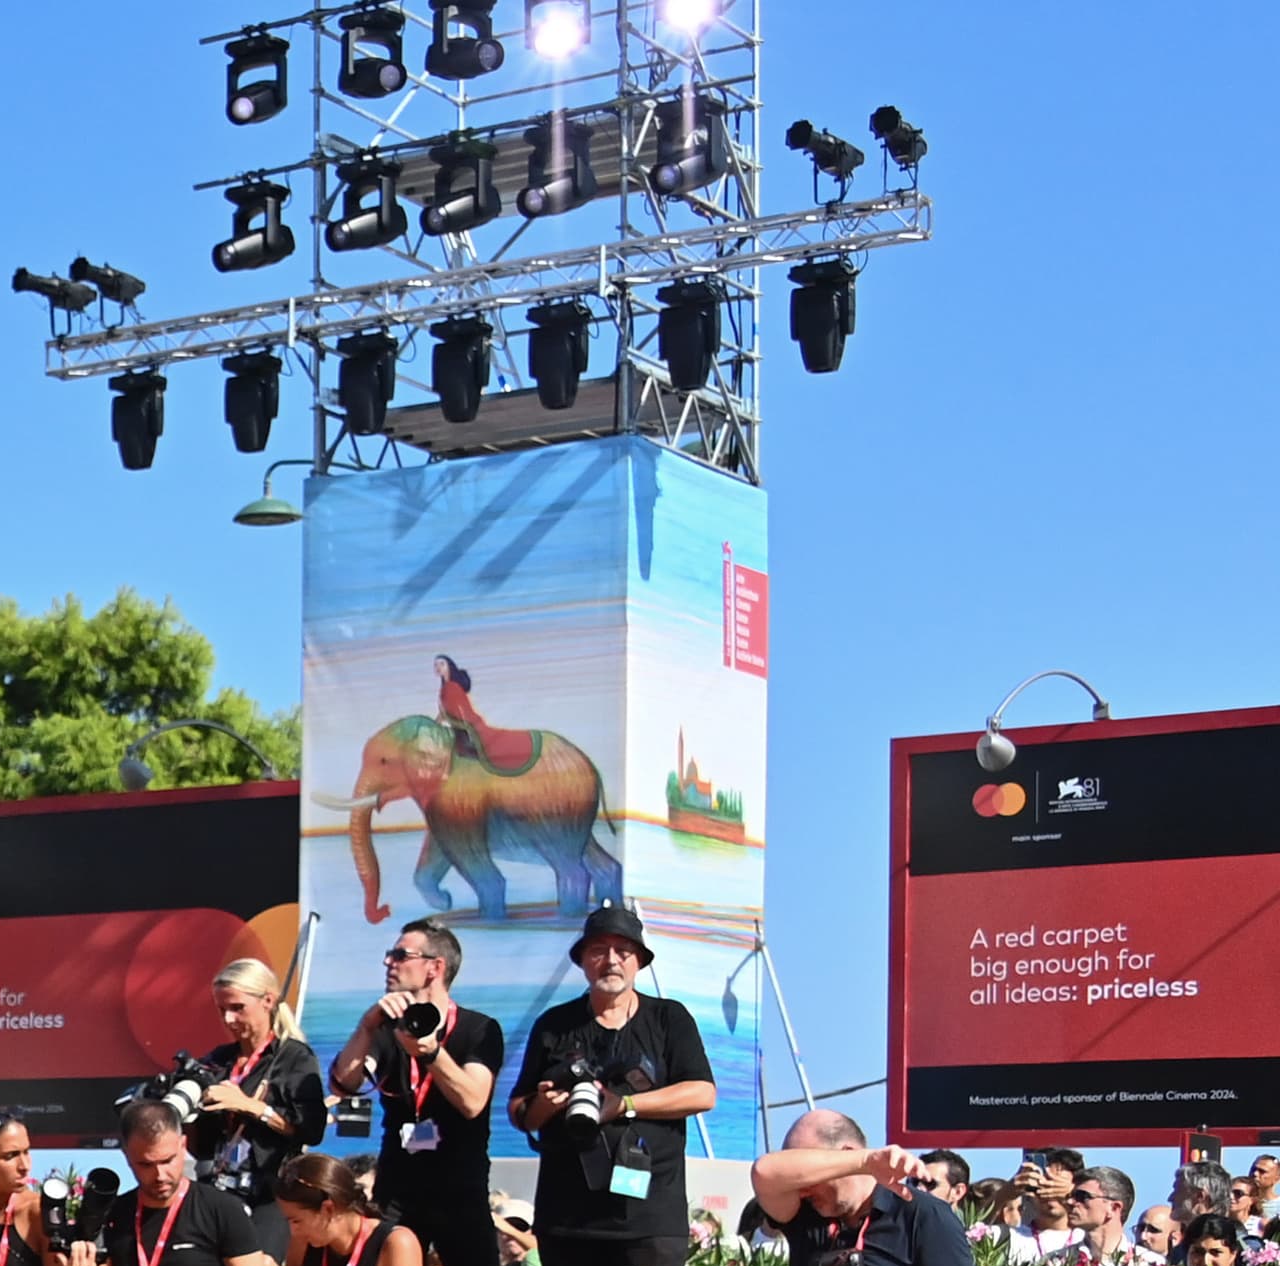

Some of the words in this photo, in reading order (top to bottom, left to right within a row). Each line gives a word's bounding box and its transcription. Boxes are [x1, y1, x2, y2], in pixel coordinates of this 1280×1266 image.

[1083, 777, 1100, 798] 81
[1011, 834, 1031, 842] main
[1032, 833, 1062, 843] sponsor
[970, 928, 989, 950] A
[995, 925, 1035, 948] red
[1042, 923, 1127, 949] carpet
[970, 955, 1008, 981] big
[1015, 950, 1109, 977] enough
[1116, 948, 1155, 971] for
[0, 988, 25, 1006] for
[970, 983, 997, 1005] all
[1005, 982, 1078, 1004] ideas:
[1087, 977, 1198, 1005] priceless
[969, 1095, 1028, 1107] Mastercard,
[1031, 1094, 1061, 1106] proud
[1063, 1093, 1103, 1105] sponsor
[1105, 1092, 1118, 1102] of
[1119, 1090, 1164, 1102] Biennale
[1166, 1089, 1207, 1101] Cinema
[1209, 1089, 1239, 1101] 2024.
